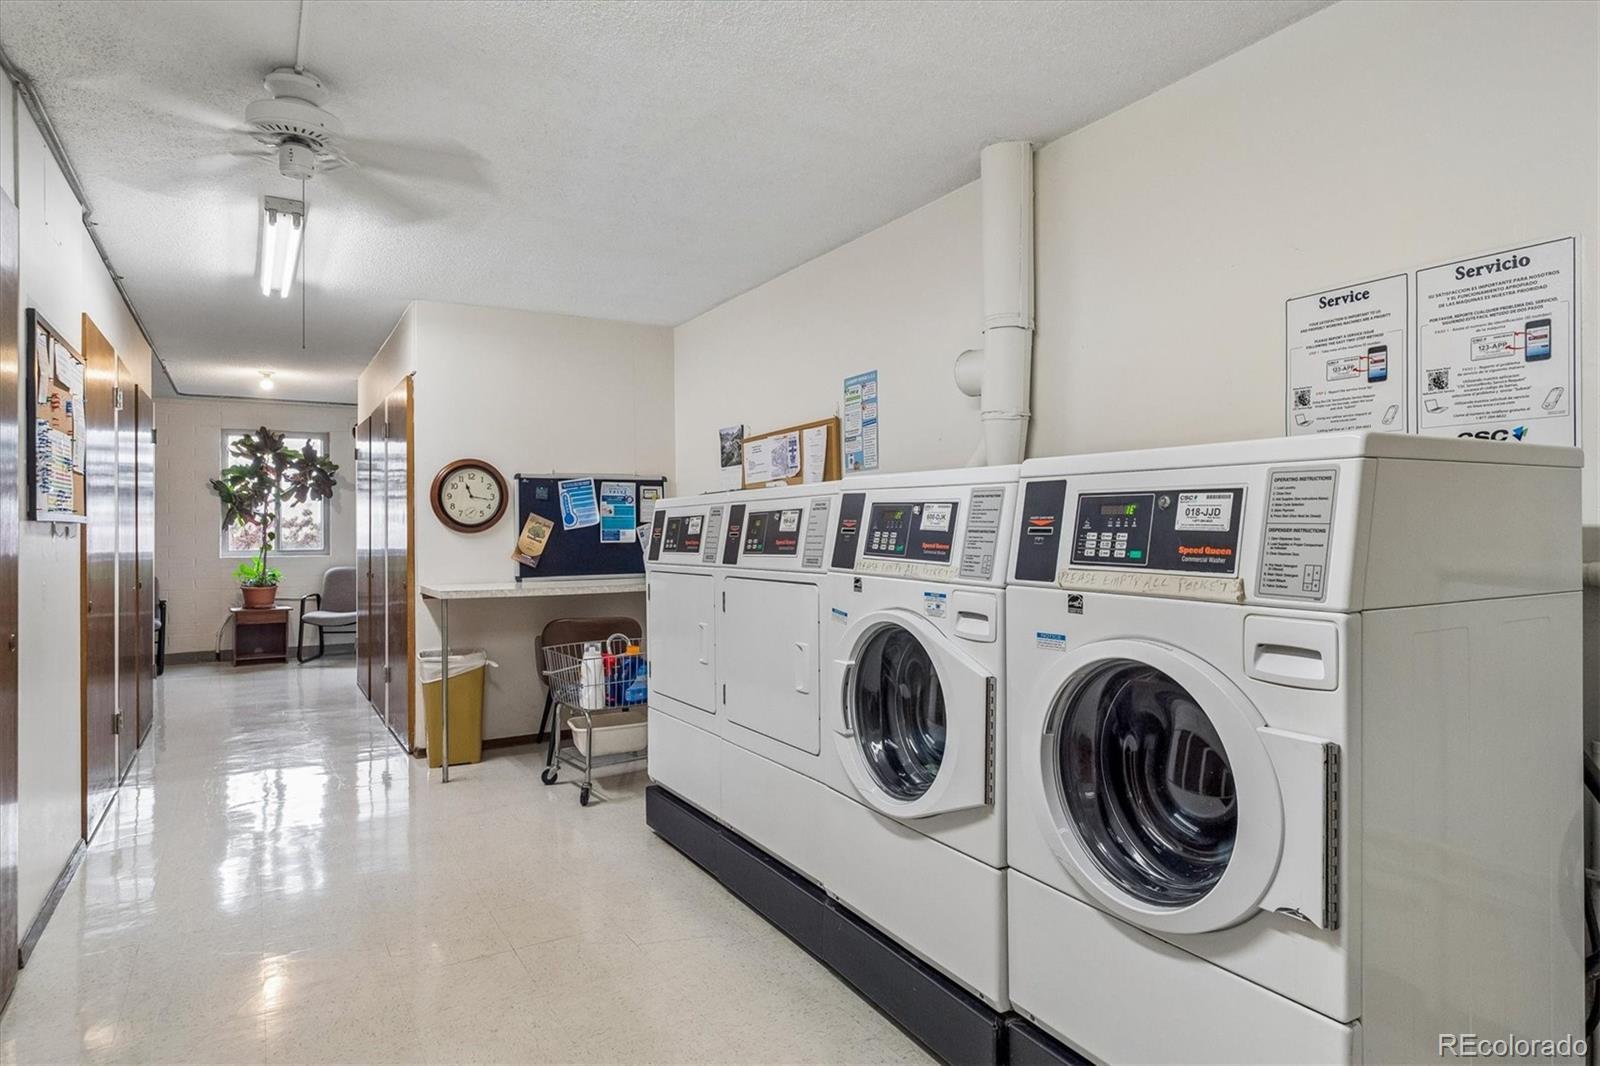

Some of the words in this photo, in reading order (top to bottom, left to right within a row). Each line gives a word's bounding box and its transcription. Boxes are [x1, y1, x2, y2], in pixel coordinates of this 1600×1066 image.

[1455, 255, 1530, 280] Servicio
[1478, 279, 1512, 290] IMPORTANTE
[1529, 269, 1560, 280] NOSOTROS
[1456, 296, 1484, 305] MAQUINAS
[1491, 290, 1515, 299] NUESTRA
[1517, 284, 1548, 294] PRIORIDAD
[1457, 286, 1505, 299] FUNCIONAMIENTO
[1505, 280, 1538, 290] APROPIADO
[1319, 290, 1370, 309] Service
[1185, 507, 1221, 517] 018-JJD
[1178, 546, 1204, 555] Speed
[1205, 546, 1232, 555] Queen
[1061, 571, 1096, 584] PLEASE
[1103, 575, 1138, 586] EMPTY
[1143, 576, 1169, 590] ALL
